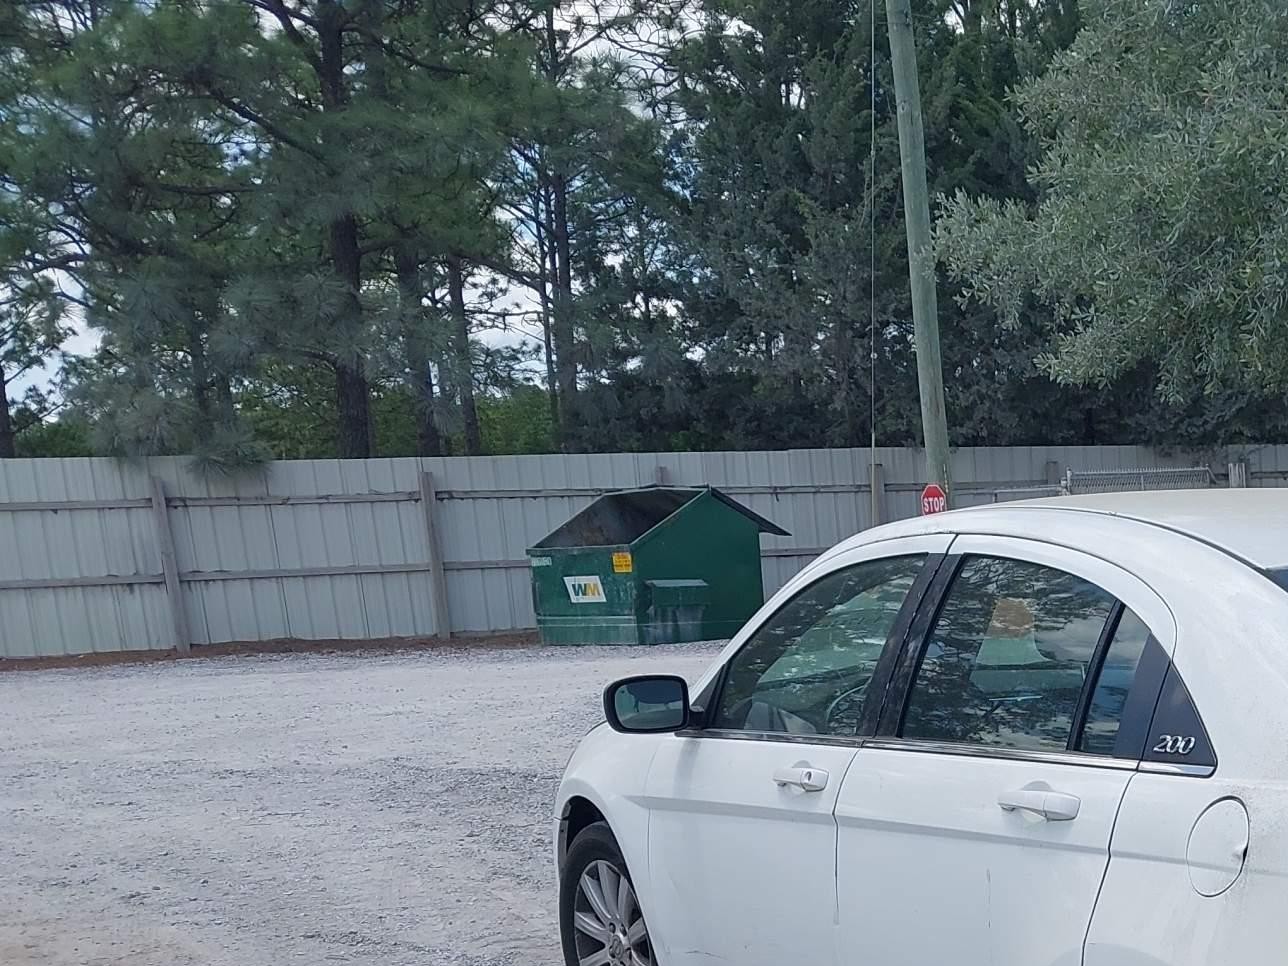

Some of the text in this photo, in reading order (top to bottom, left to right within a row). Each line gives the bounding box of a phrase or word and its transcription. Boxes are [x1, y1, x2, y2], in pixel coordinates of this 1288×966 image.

[924, 497, 944, 512] STOP
[572, 583, 601, 596] WM
[1153, 734, 1195, 754] 200
